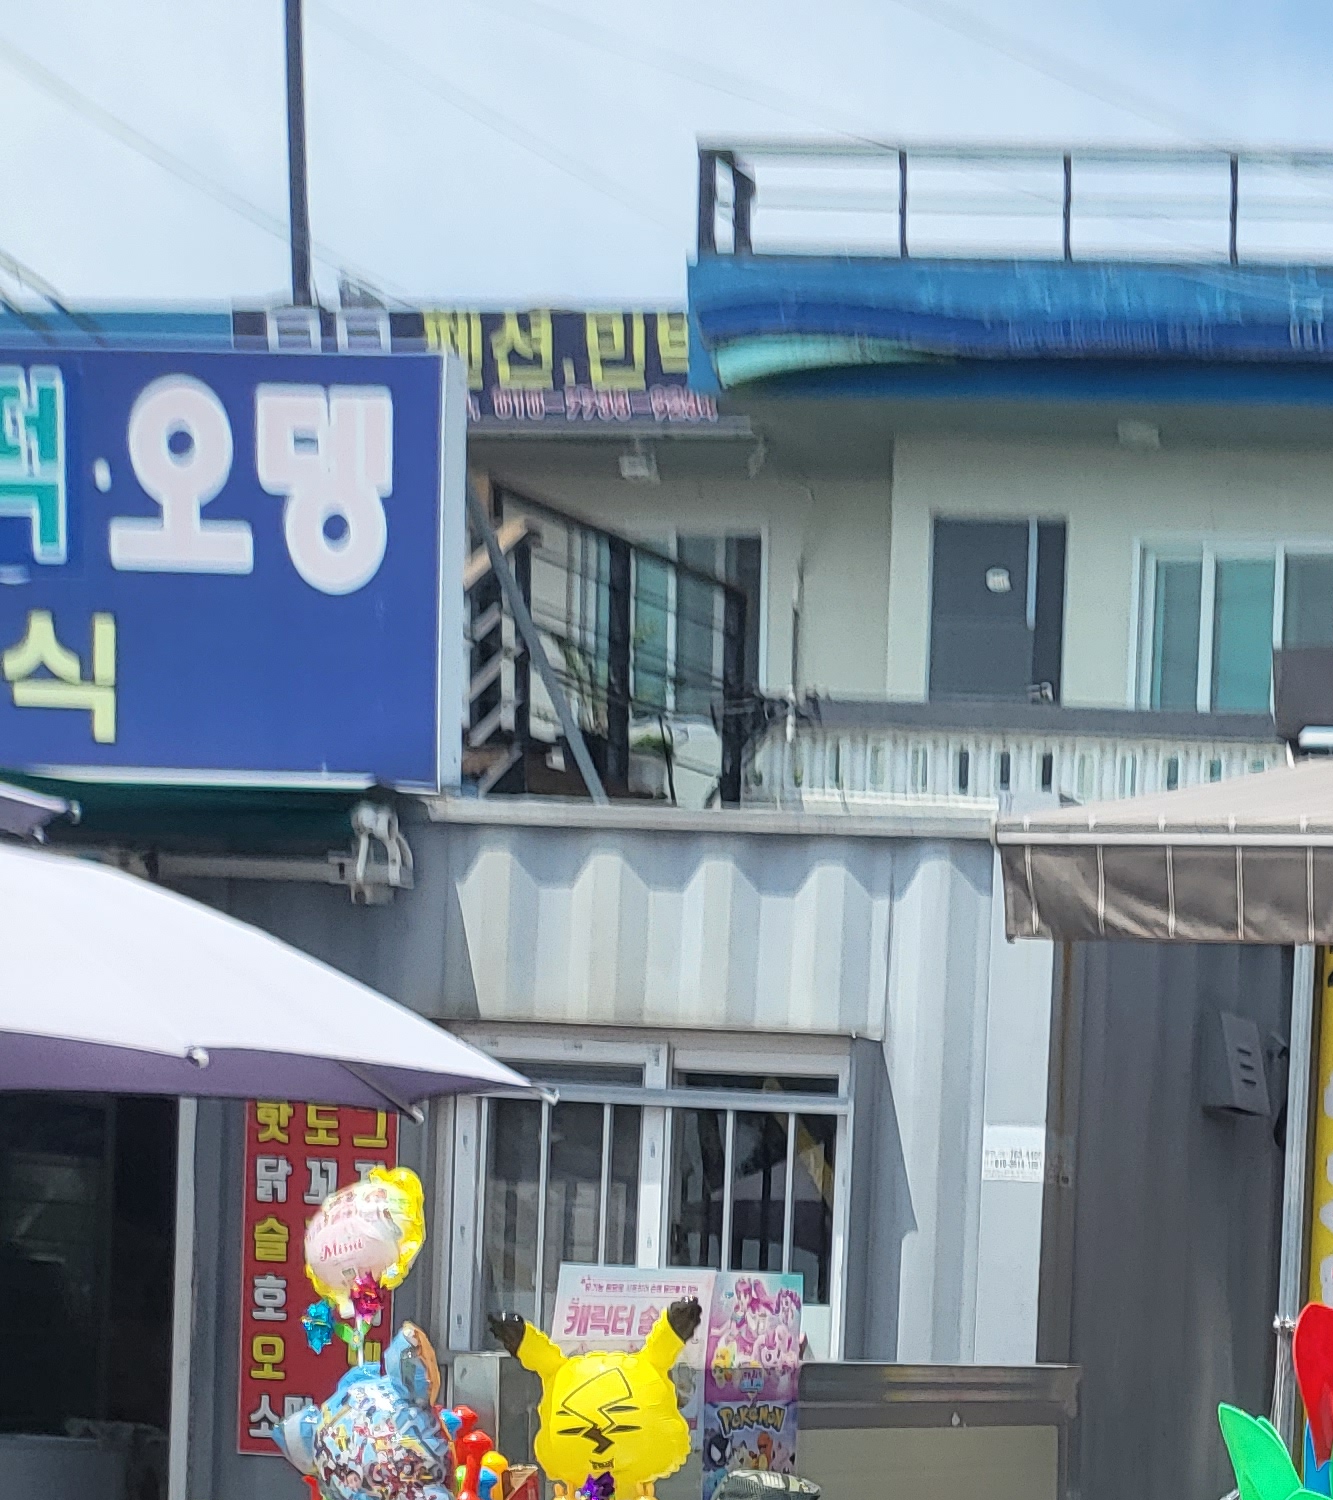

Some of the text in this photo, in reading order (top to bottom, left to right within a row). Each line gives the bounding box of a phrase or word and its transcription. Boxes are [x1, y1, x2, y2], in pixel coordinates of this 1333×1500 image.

[256, 1101, 390, 1149] 핫도그
[255, 1156, 386, 1204] 닭꼬
[564, 1304, 635, 1336] 캐릭터
